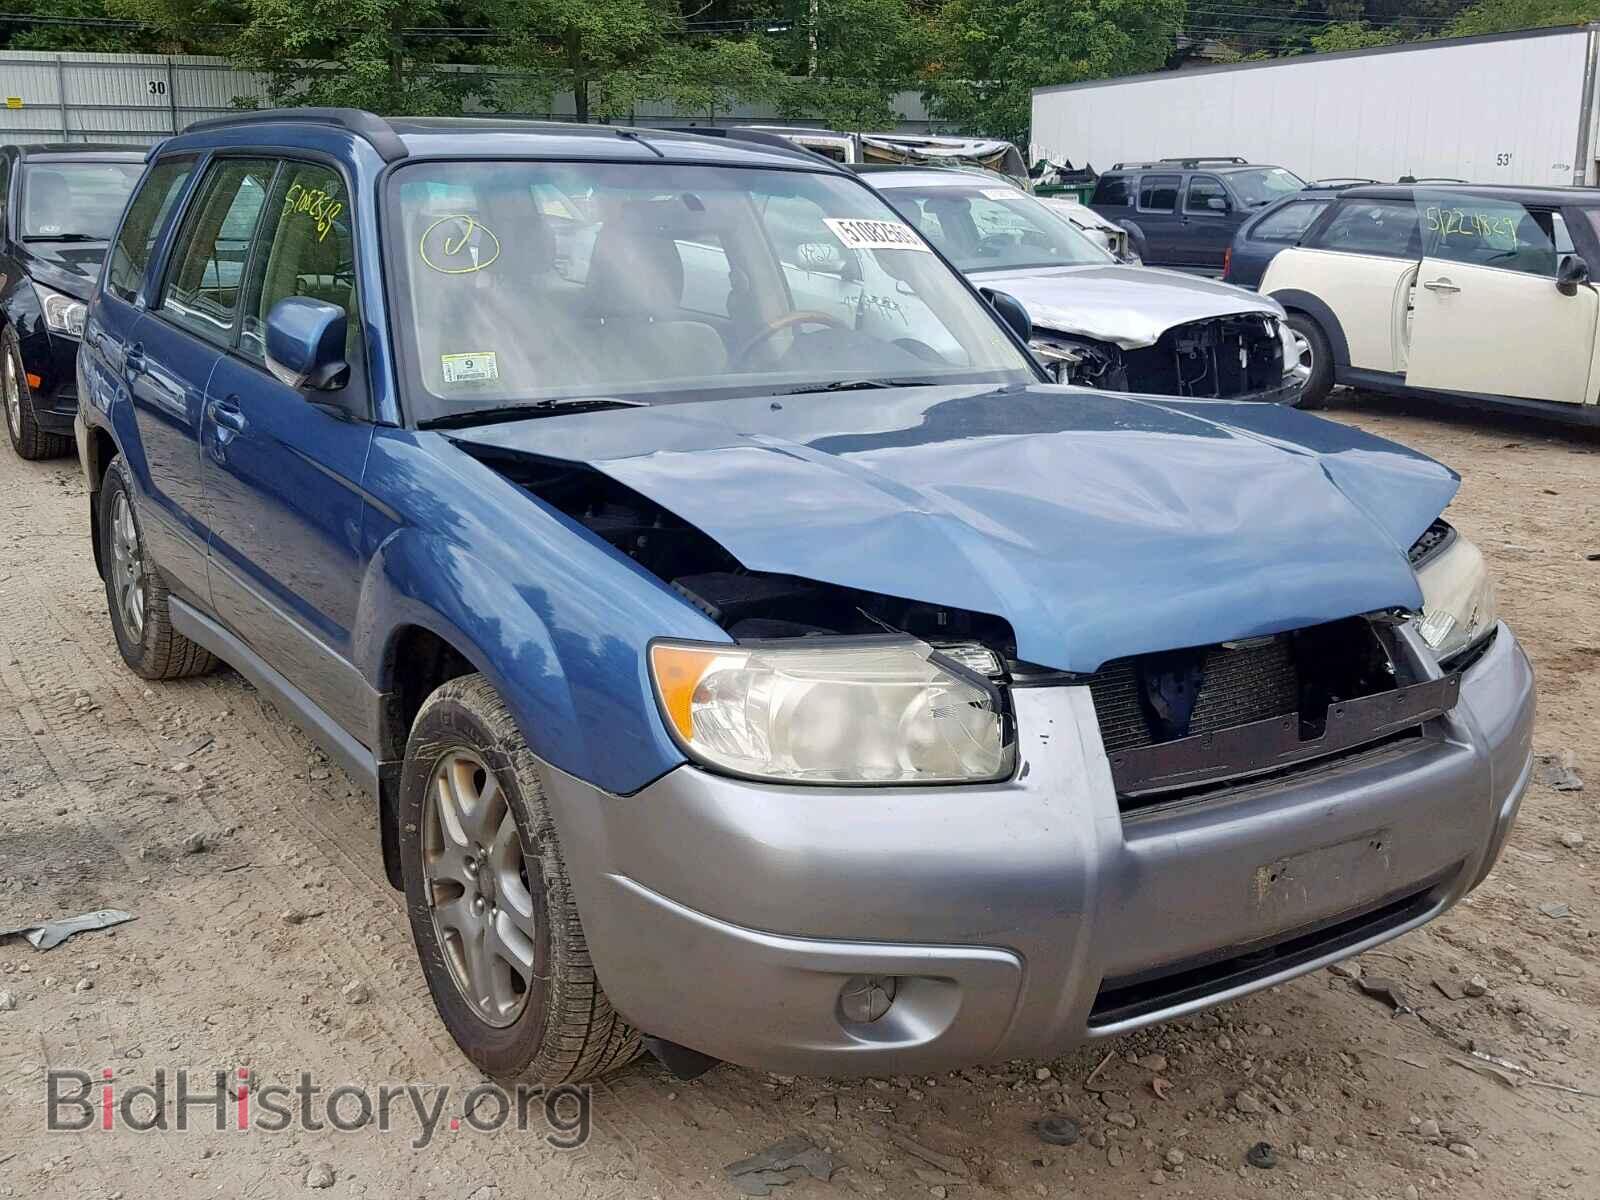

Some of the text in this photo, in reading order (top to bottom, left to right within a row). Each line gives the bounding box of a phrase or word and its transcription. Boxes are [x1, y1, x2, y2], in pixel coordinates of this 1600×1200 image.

[149, 81, 165, 95] 30
[1496, 153, 1513, 167] 53'
[464, 359, 474, 369] 9
